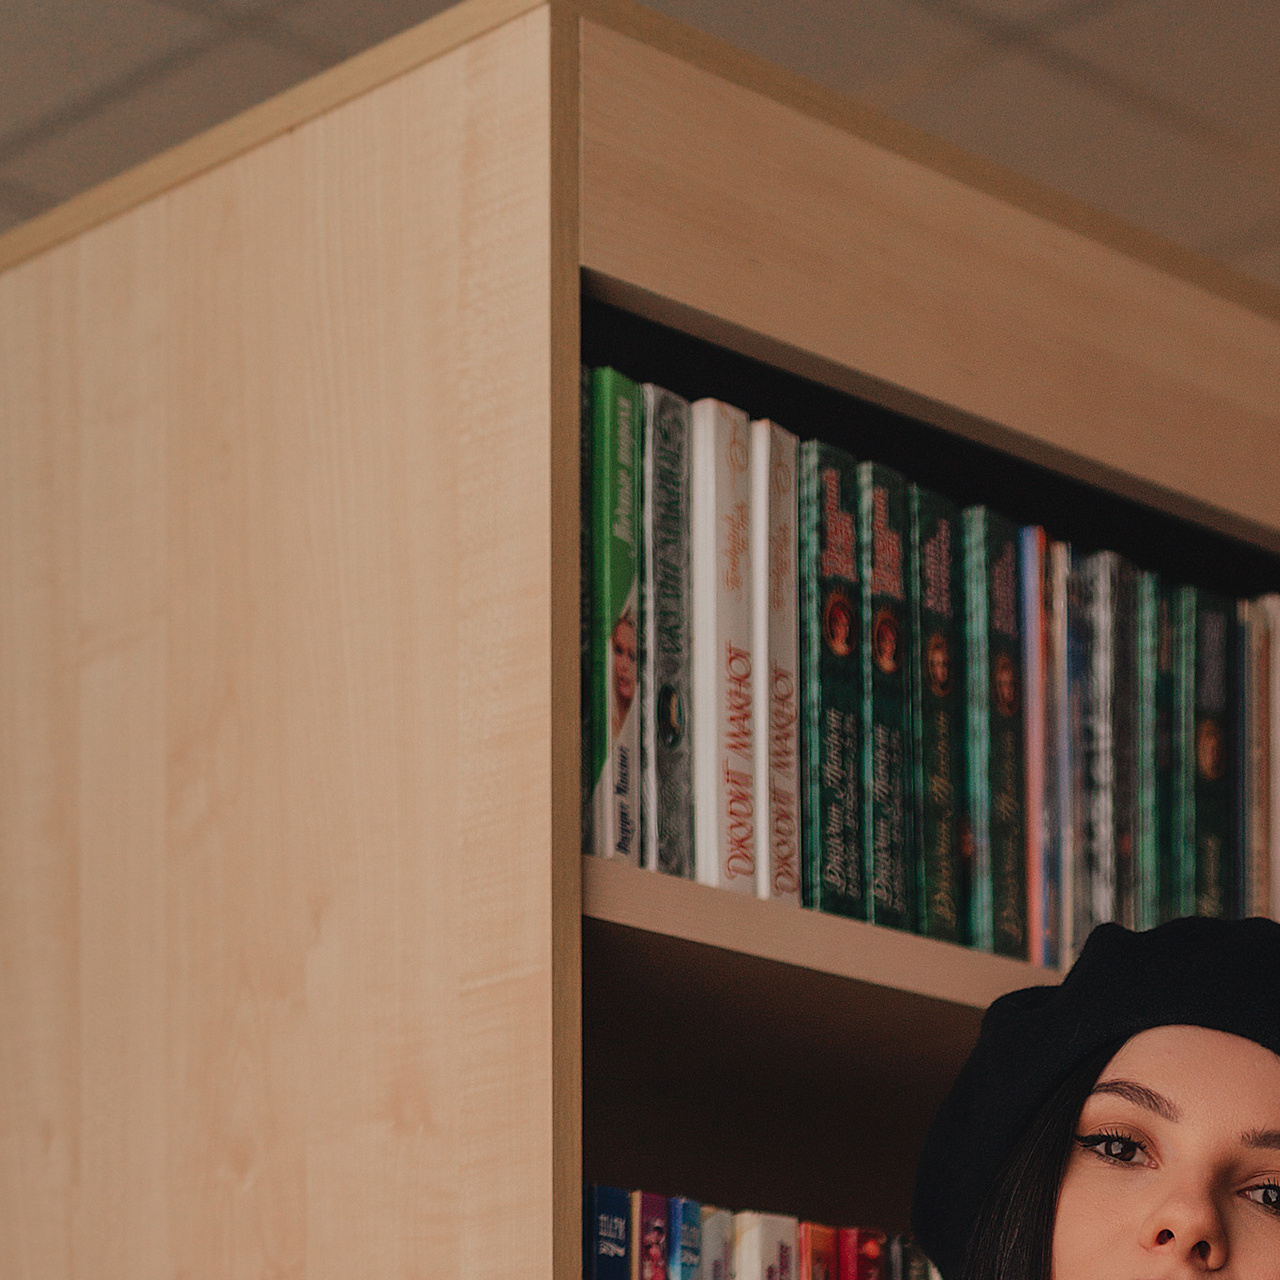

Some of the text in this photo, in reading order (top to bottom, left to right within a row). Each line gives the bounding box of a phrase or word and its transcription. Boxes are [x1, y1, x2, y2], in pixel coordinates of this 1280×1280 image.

[724, 641, 755, 880] ДЖУДИТ МАКНОТ
[769, 666, 798, 896] ДЖУДИТ МАКНОТ
